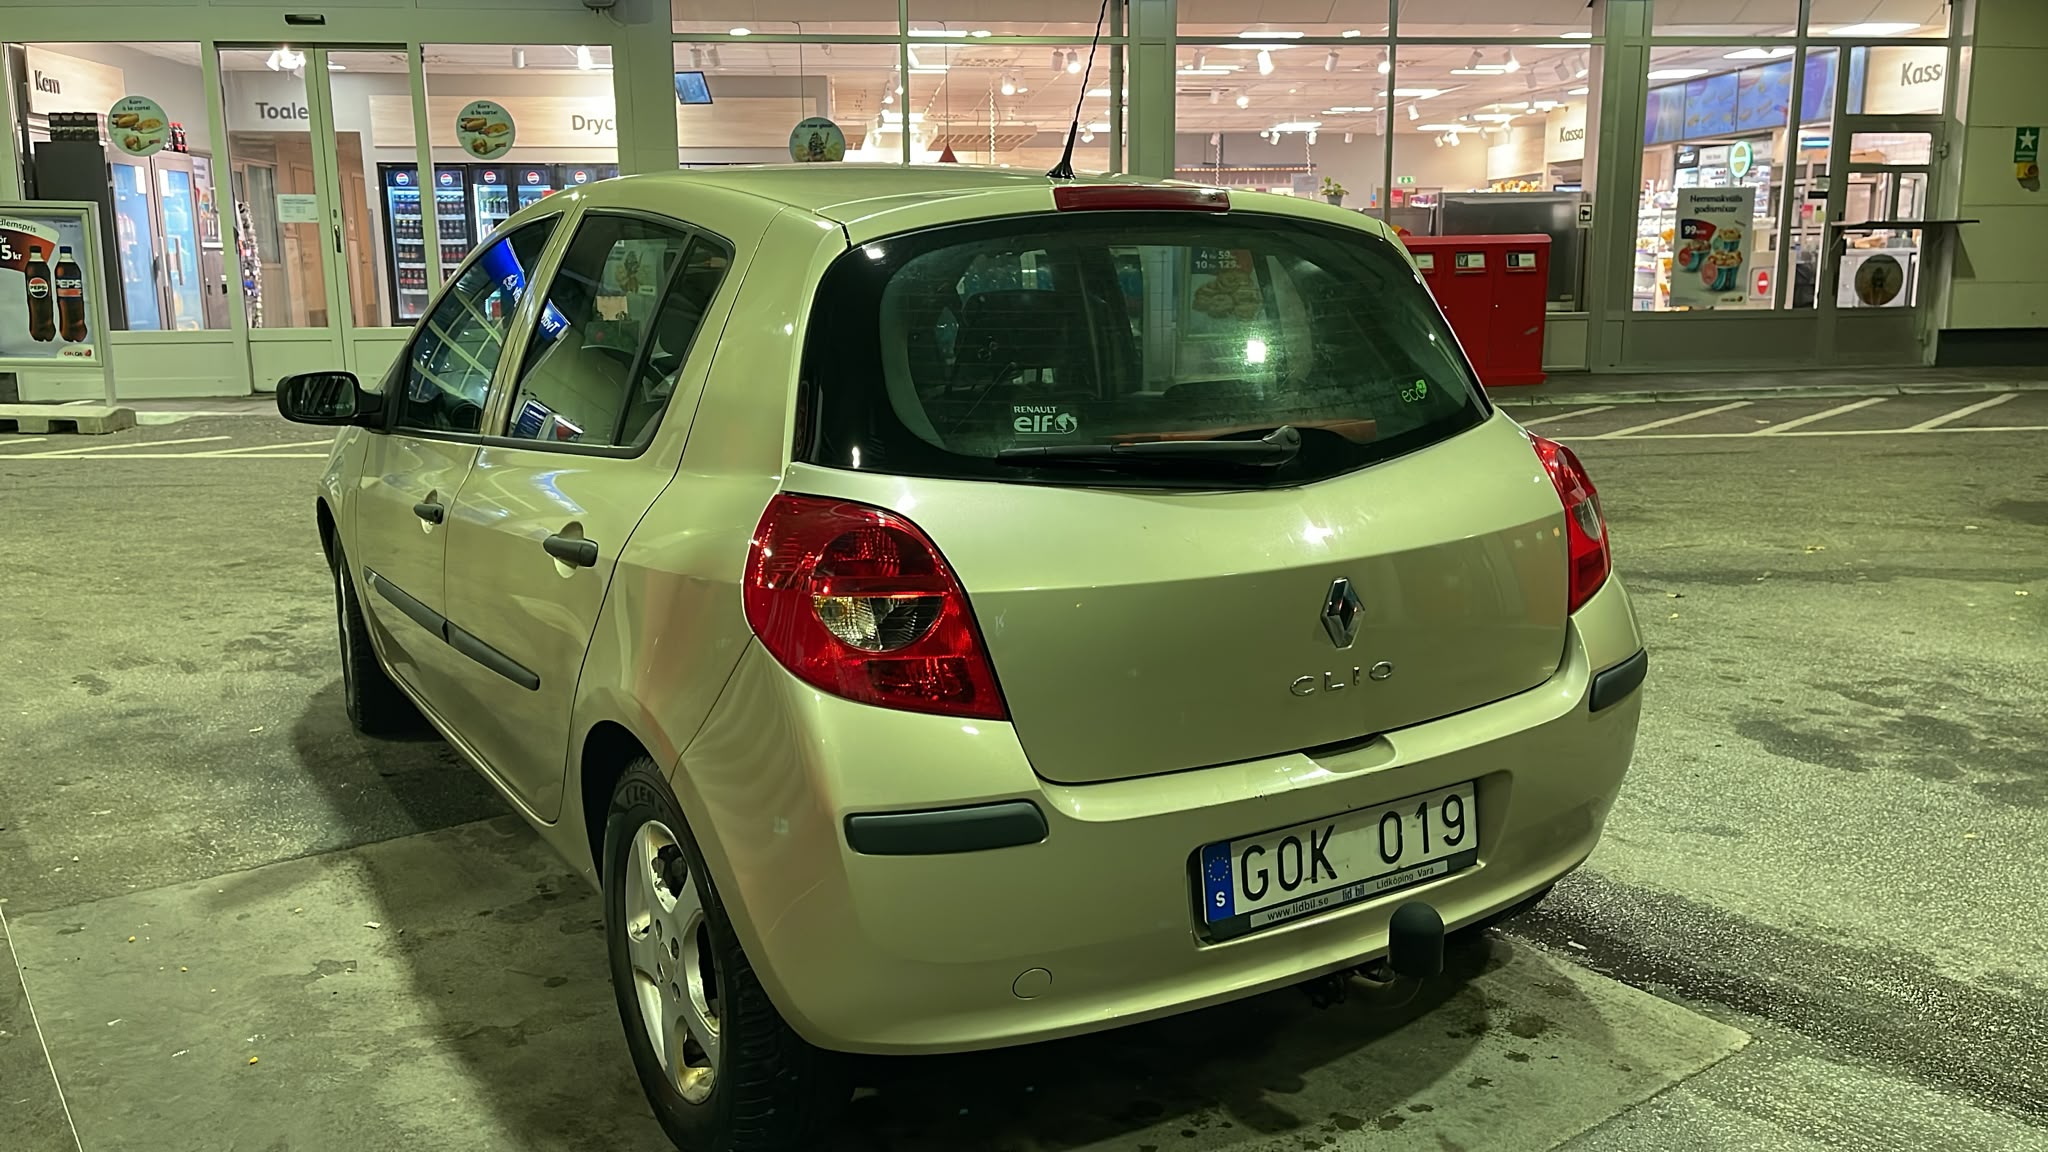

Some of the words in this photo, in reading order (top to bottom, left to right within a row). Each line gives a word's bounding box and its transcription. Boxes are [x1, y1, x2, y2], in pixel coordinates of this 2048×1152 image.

[34, 70, 61, 94] Kem
[1901, 61, 1944, 86] Kass
[255, 102, 309, 119] Toale
[571, 114, 614, 135] Dryc
[1560, 126, 1583, 142] Kassa
[1684, 225, 1697, 235] 99
[12, 251, 22, 260] kr
[1200, 250, 1208, 260] 4
[1195, 260, 1208, 269] 10
[1013, 405, 1057, 414] RENAULT
[1013, 415, 1054, 433] elf
[1290, 661, 1393, 697] CLIO
[1241, 824, 1338, 901] GOK
[1379, 794, 1465, 865] 019
[1215, 891, 1226, 907] S
[1267, 897, 1329, 921] www.lidbil.se
[1376, 873, 1414, 890] Lidköping
[1417, 866, 1434, 879] Vara
